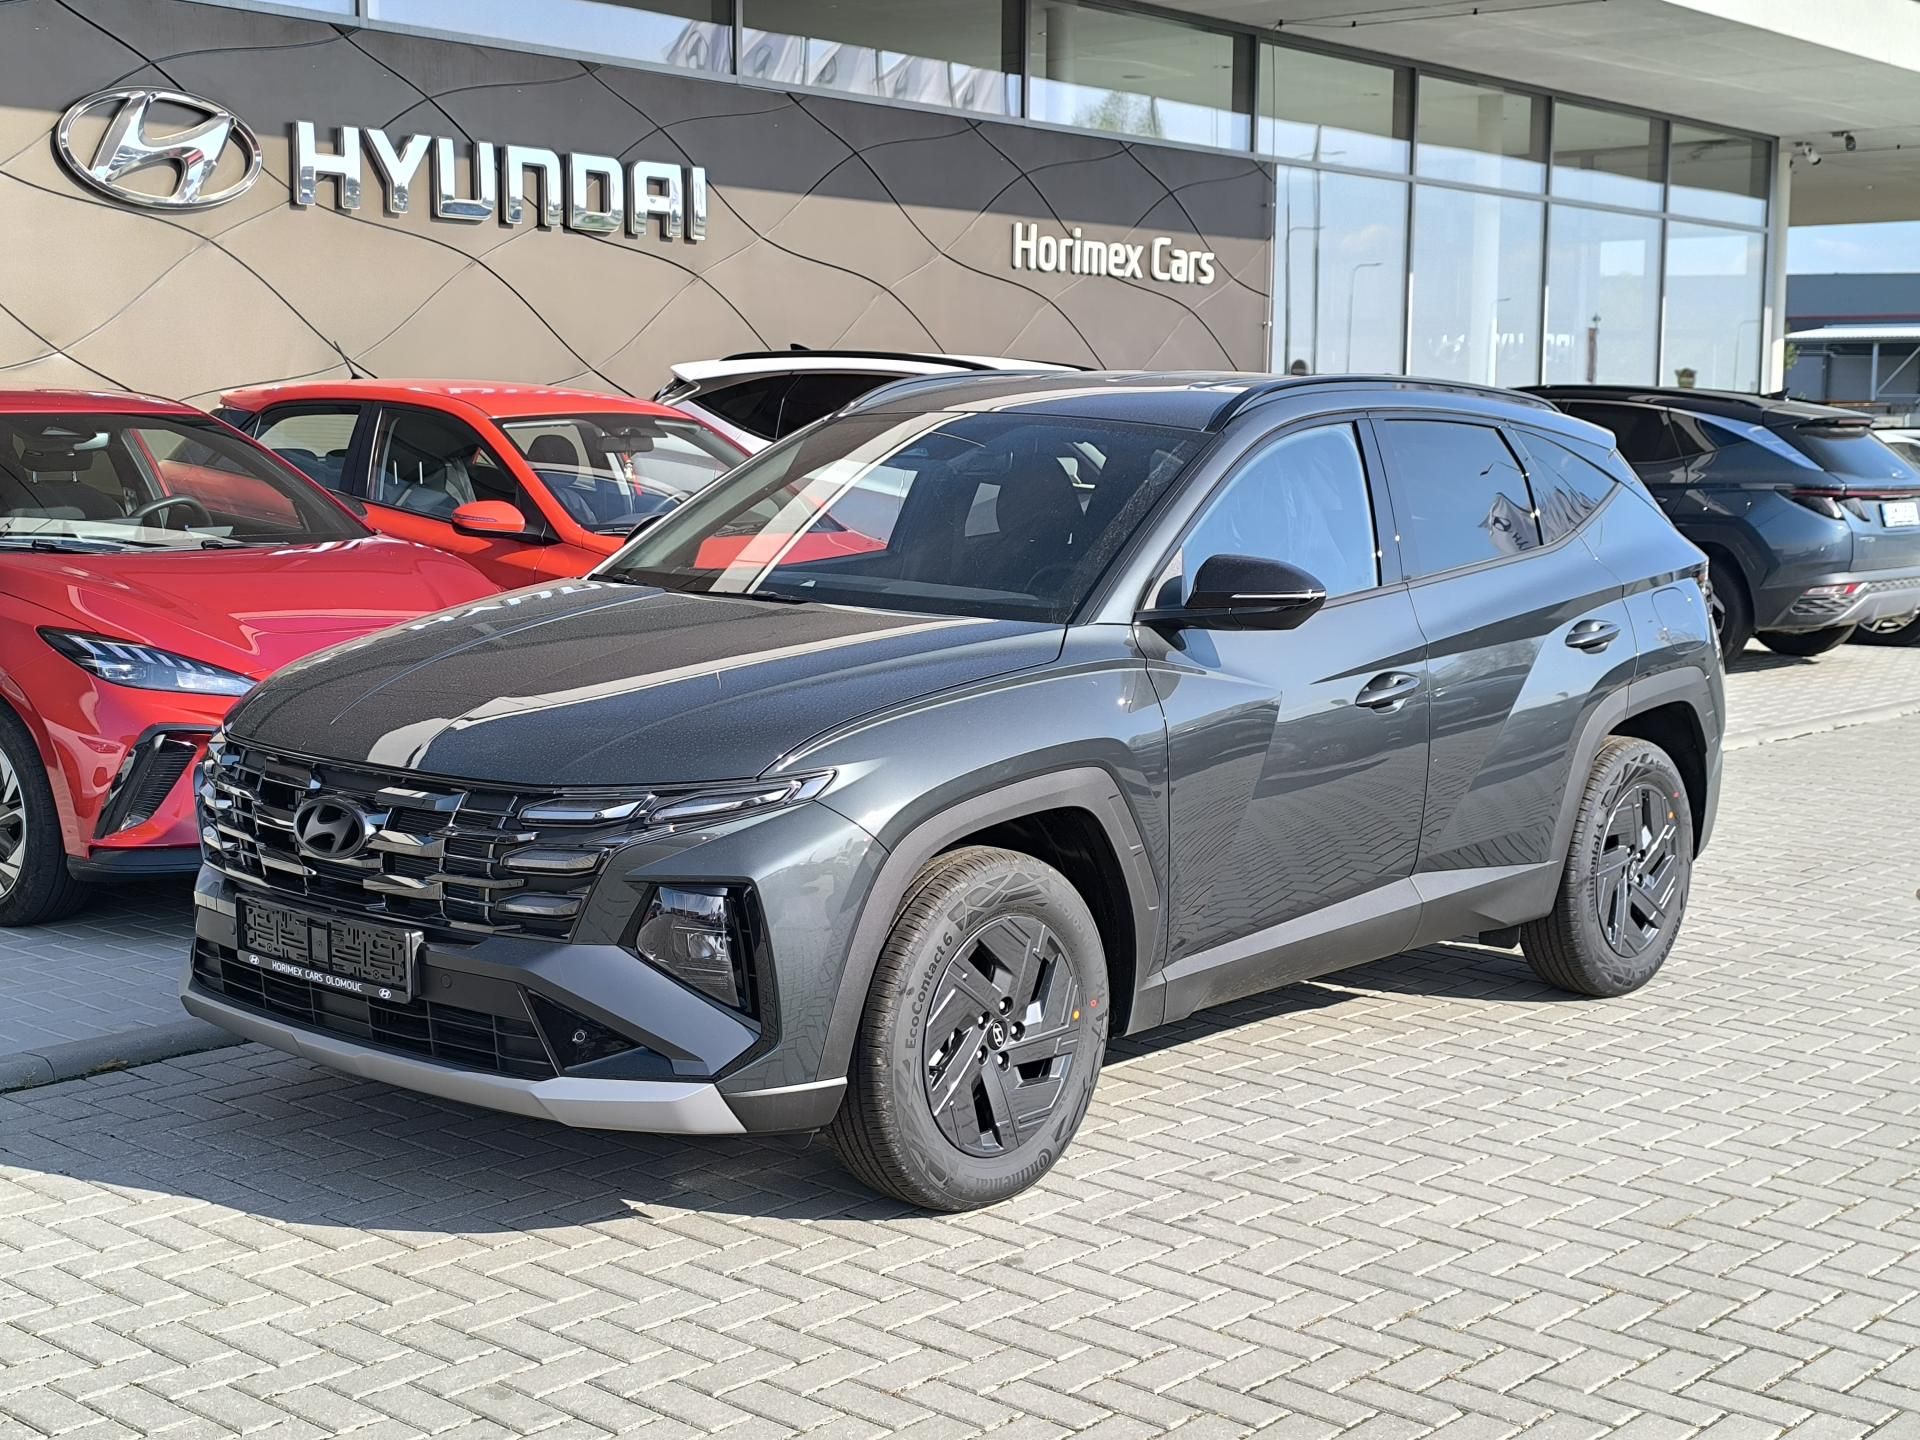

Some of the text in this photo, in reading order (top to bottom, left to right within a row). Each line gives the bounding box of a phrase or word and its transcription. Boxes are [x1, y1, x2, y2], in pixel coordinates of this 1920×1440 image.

[292, 119, 708, 242] HYUNDAI
[1012, 221, 1215, 284] Horimex Cars
[272, 960, 363, 993] HORIMEX CARS OLOMOUC
[905, 931, 953, 1049] EcoContact 6
